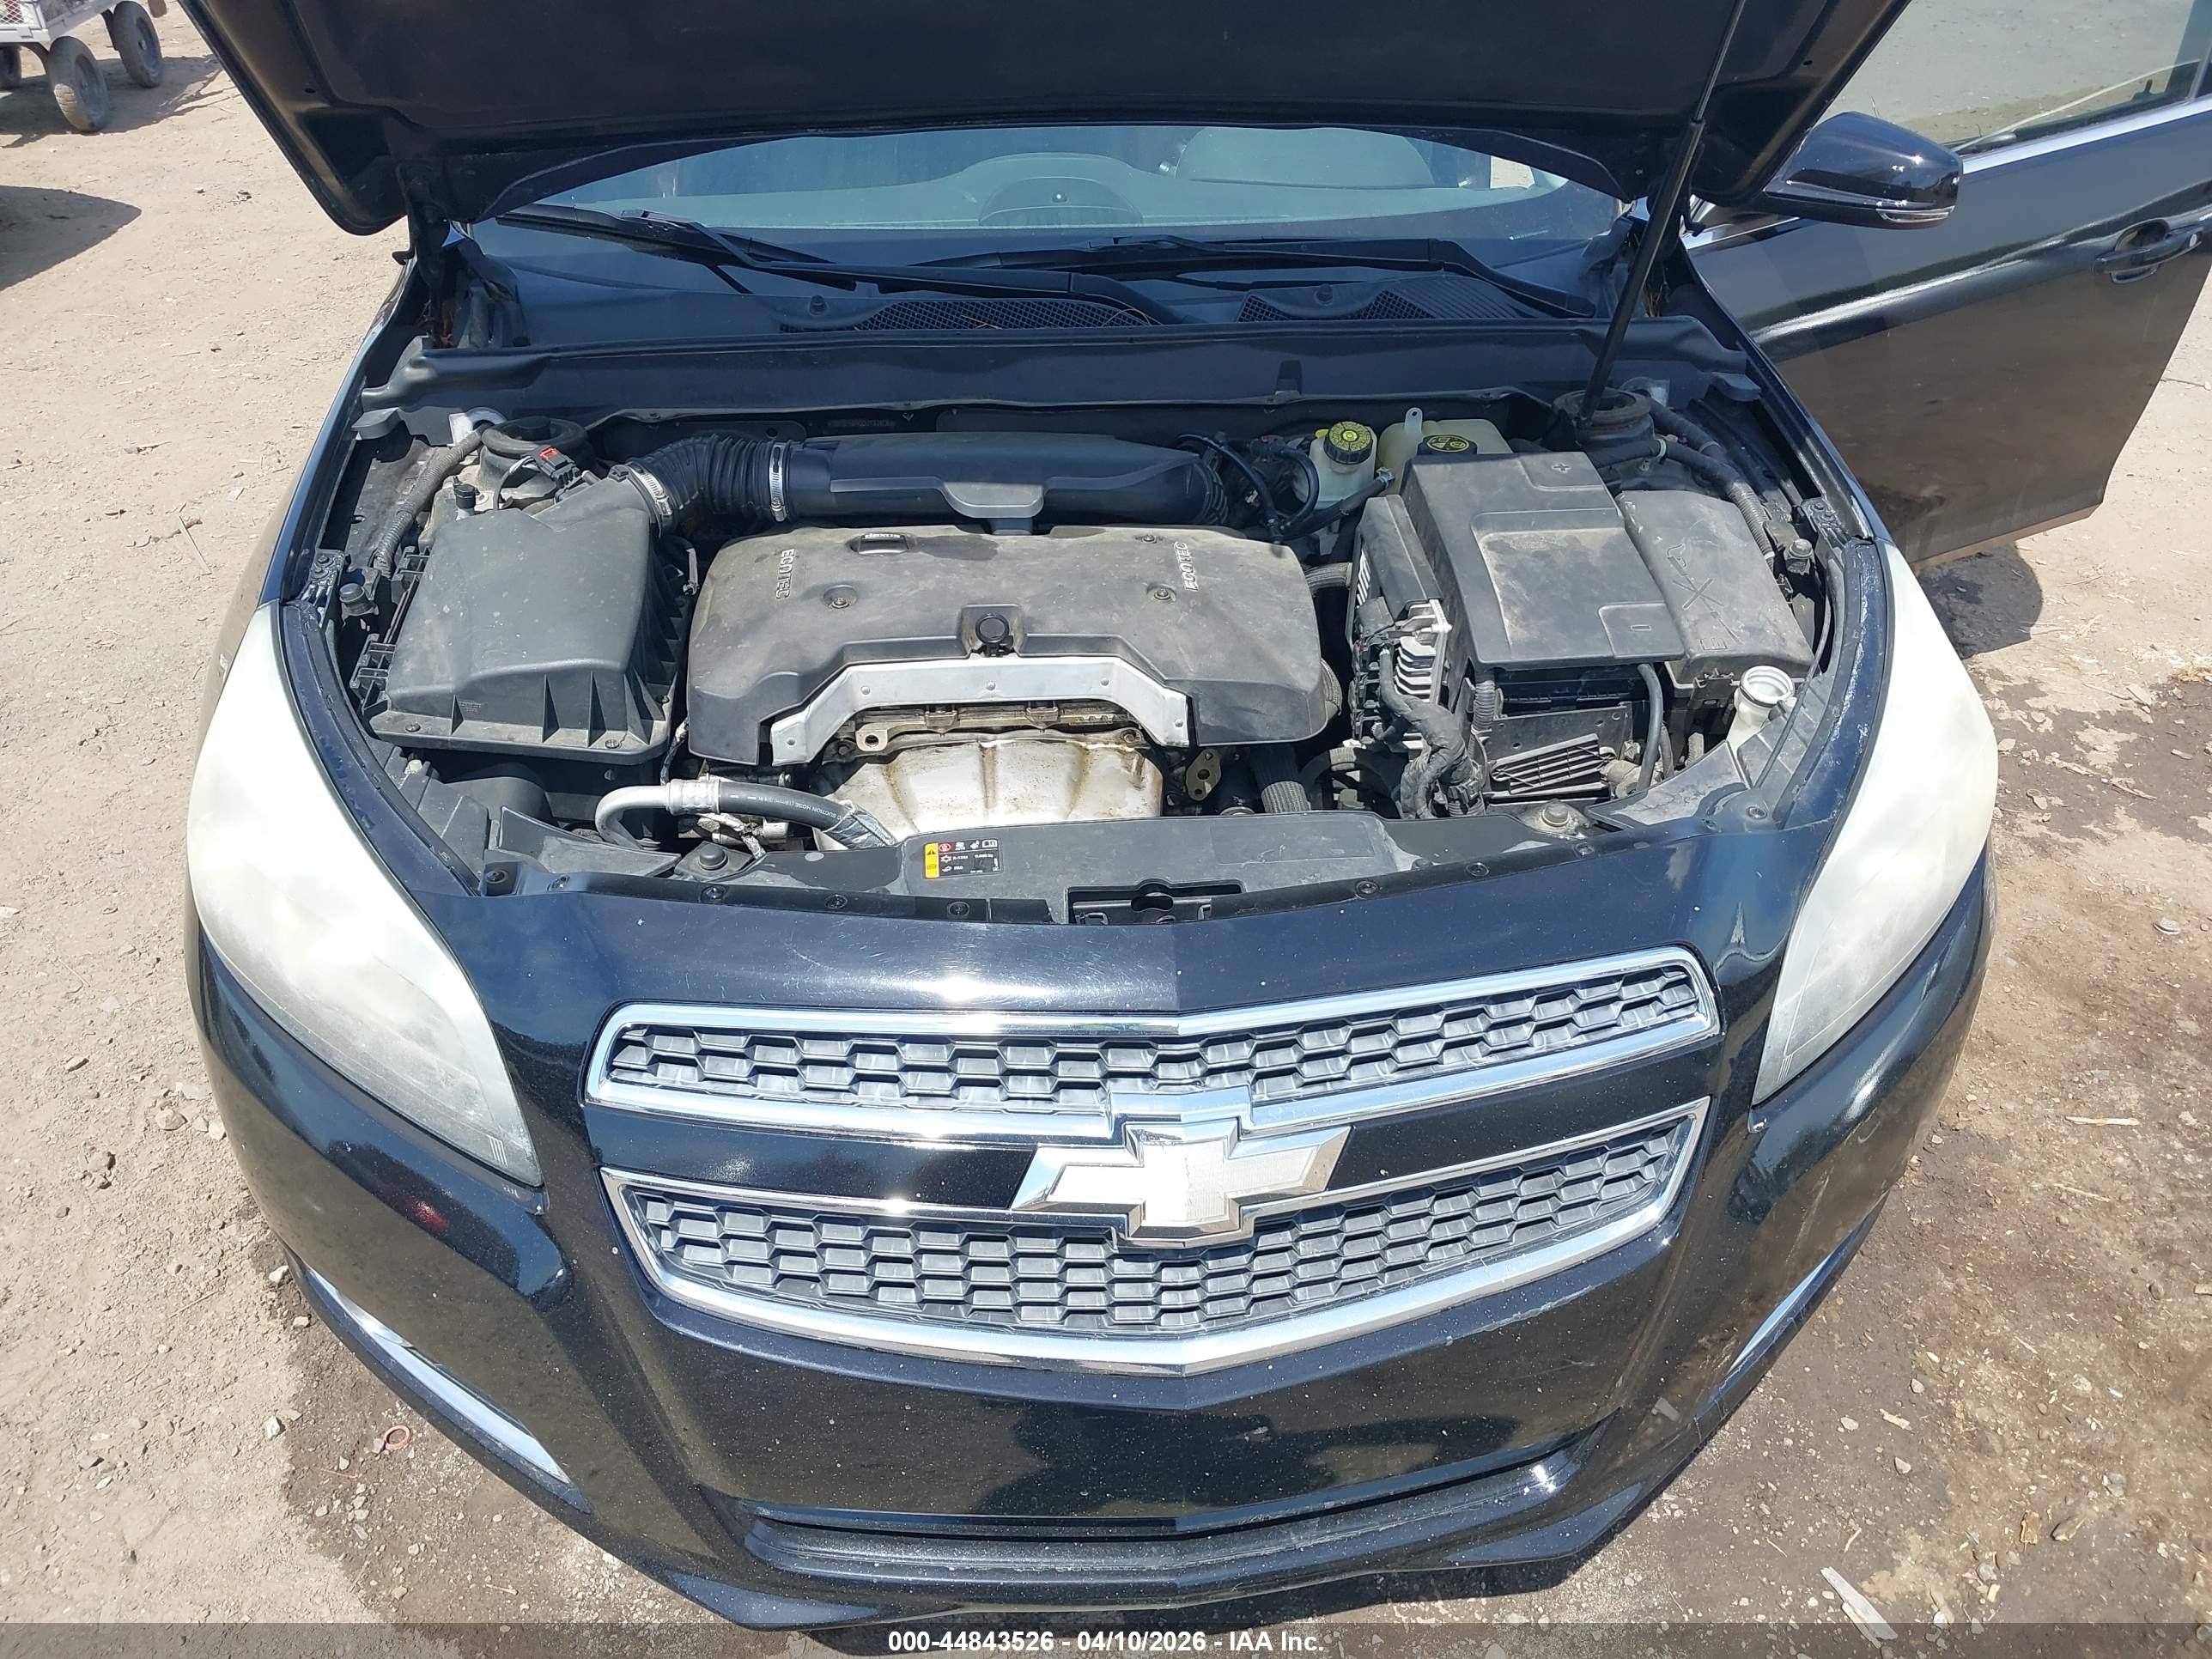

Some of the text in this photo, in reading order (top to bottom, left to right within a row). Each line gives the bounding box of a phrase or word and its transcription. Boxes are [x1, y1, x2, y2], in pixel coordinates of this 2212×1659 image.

[775, 548, 795, 599] ECOTEC
[1174, 541, 1199, 592] ECOTEC
[795, 802, 811, 811] HOSE
[811, 806, 836, 818] SUCTION
